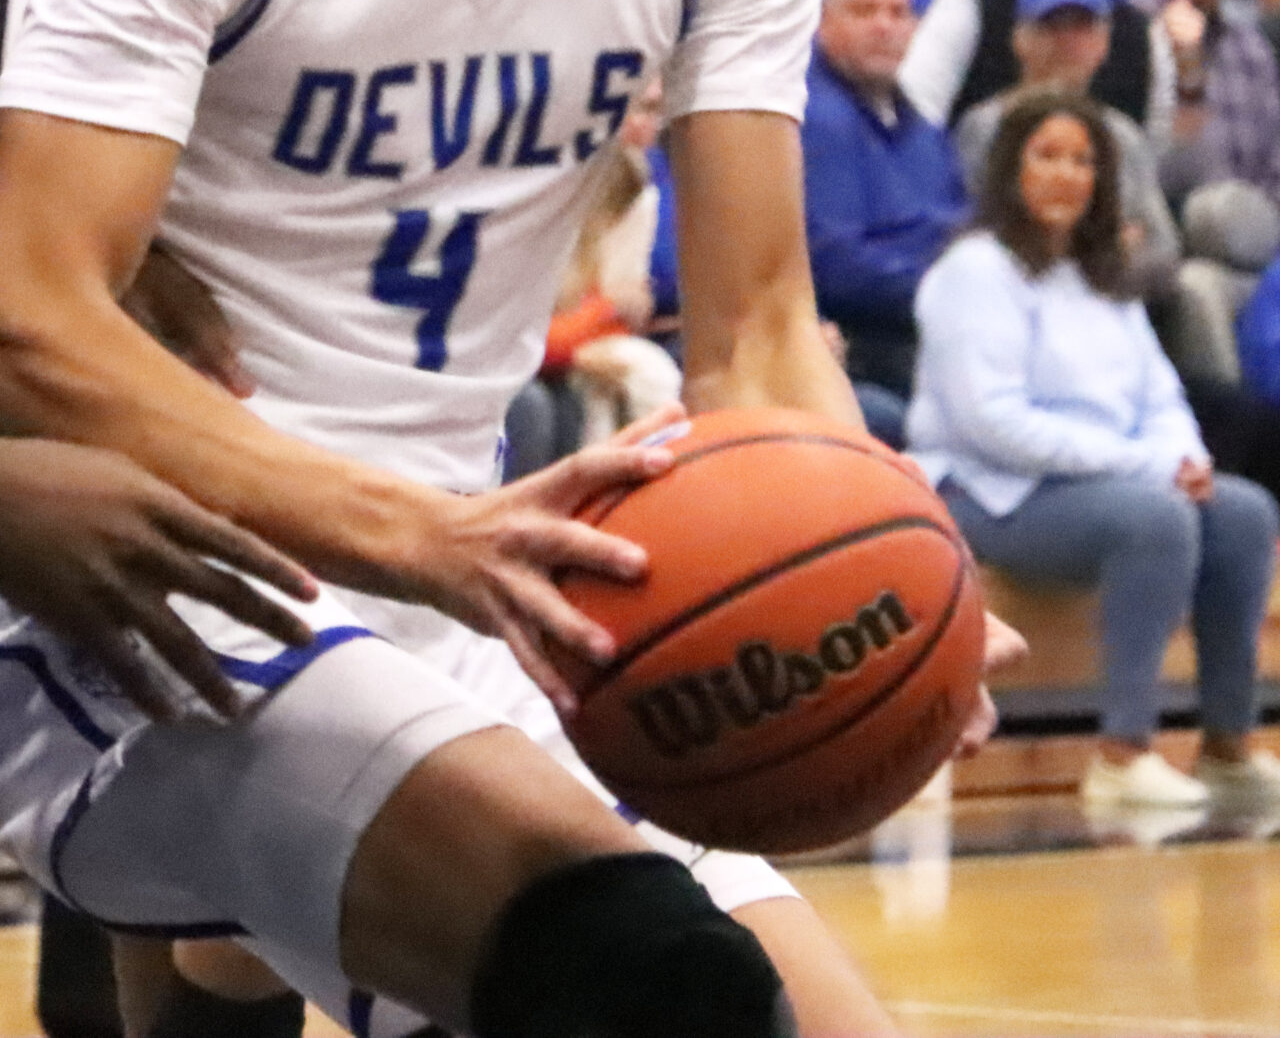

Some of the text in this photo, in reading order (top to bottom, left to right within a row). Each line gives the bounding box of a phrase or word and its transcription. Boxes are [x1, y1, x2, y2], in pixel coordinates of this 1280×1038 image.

[273, 48, 644, 181] DEVILS
[370, 208, 494, 372] 4
[632, 589, 914, 758] Wilson
